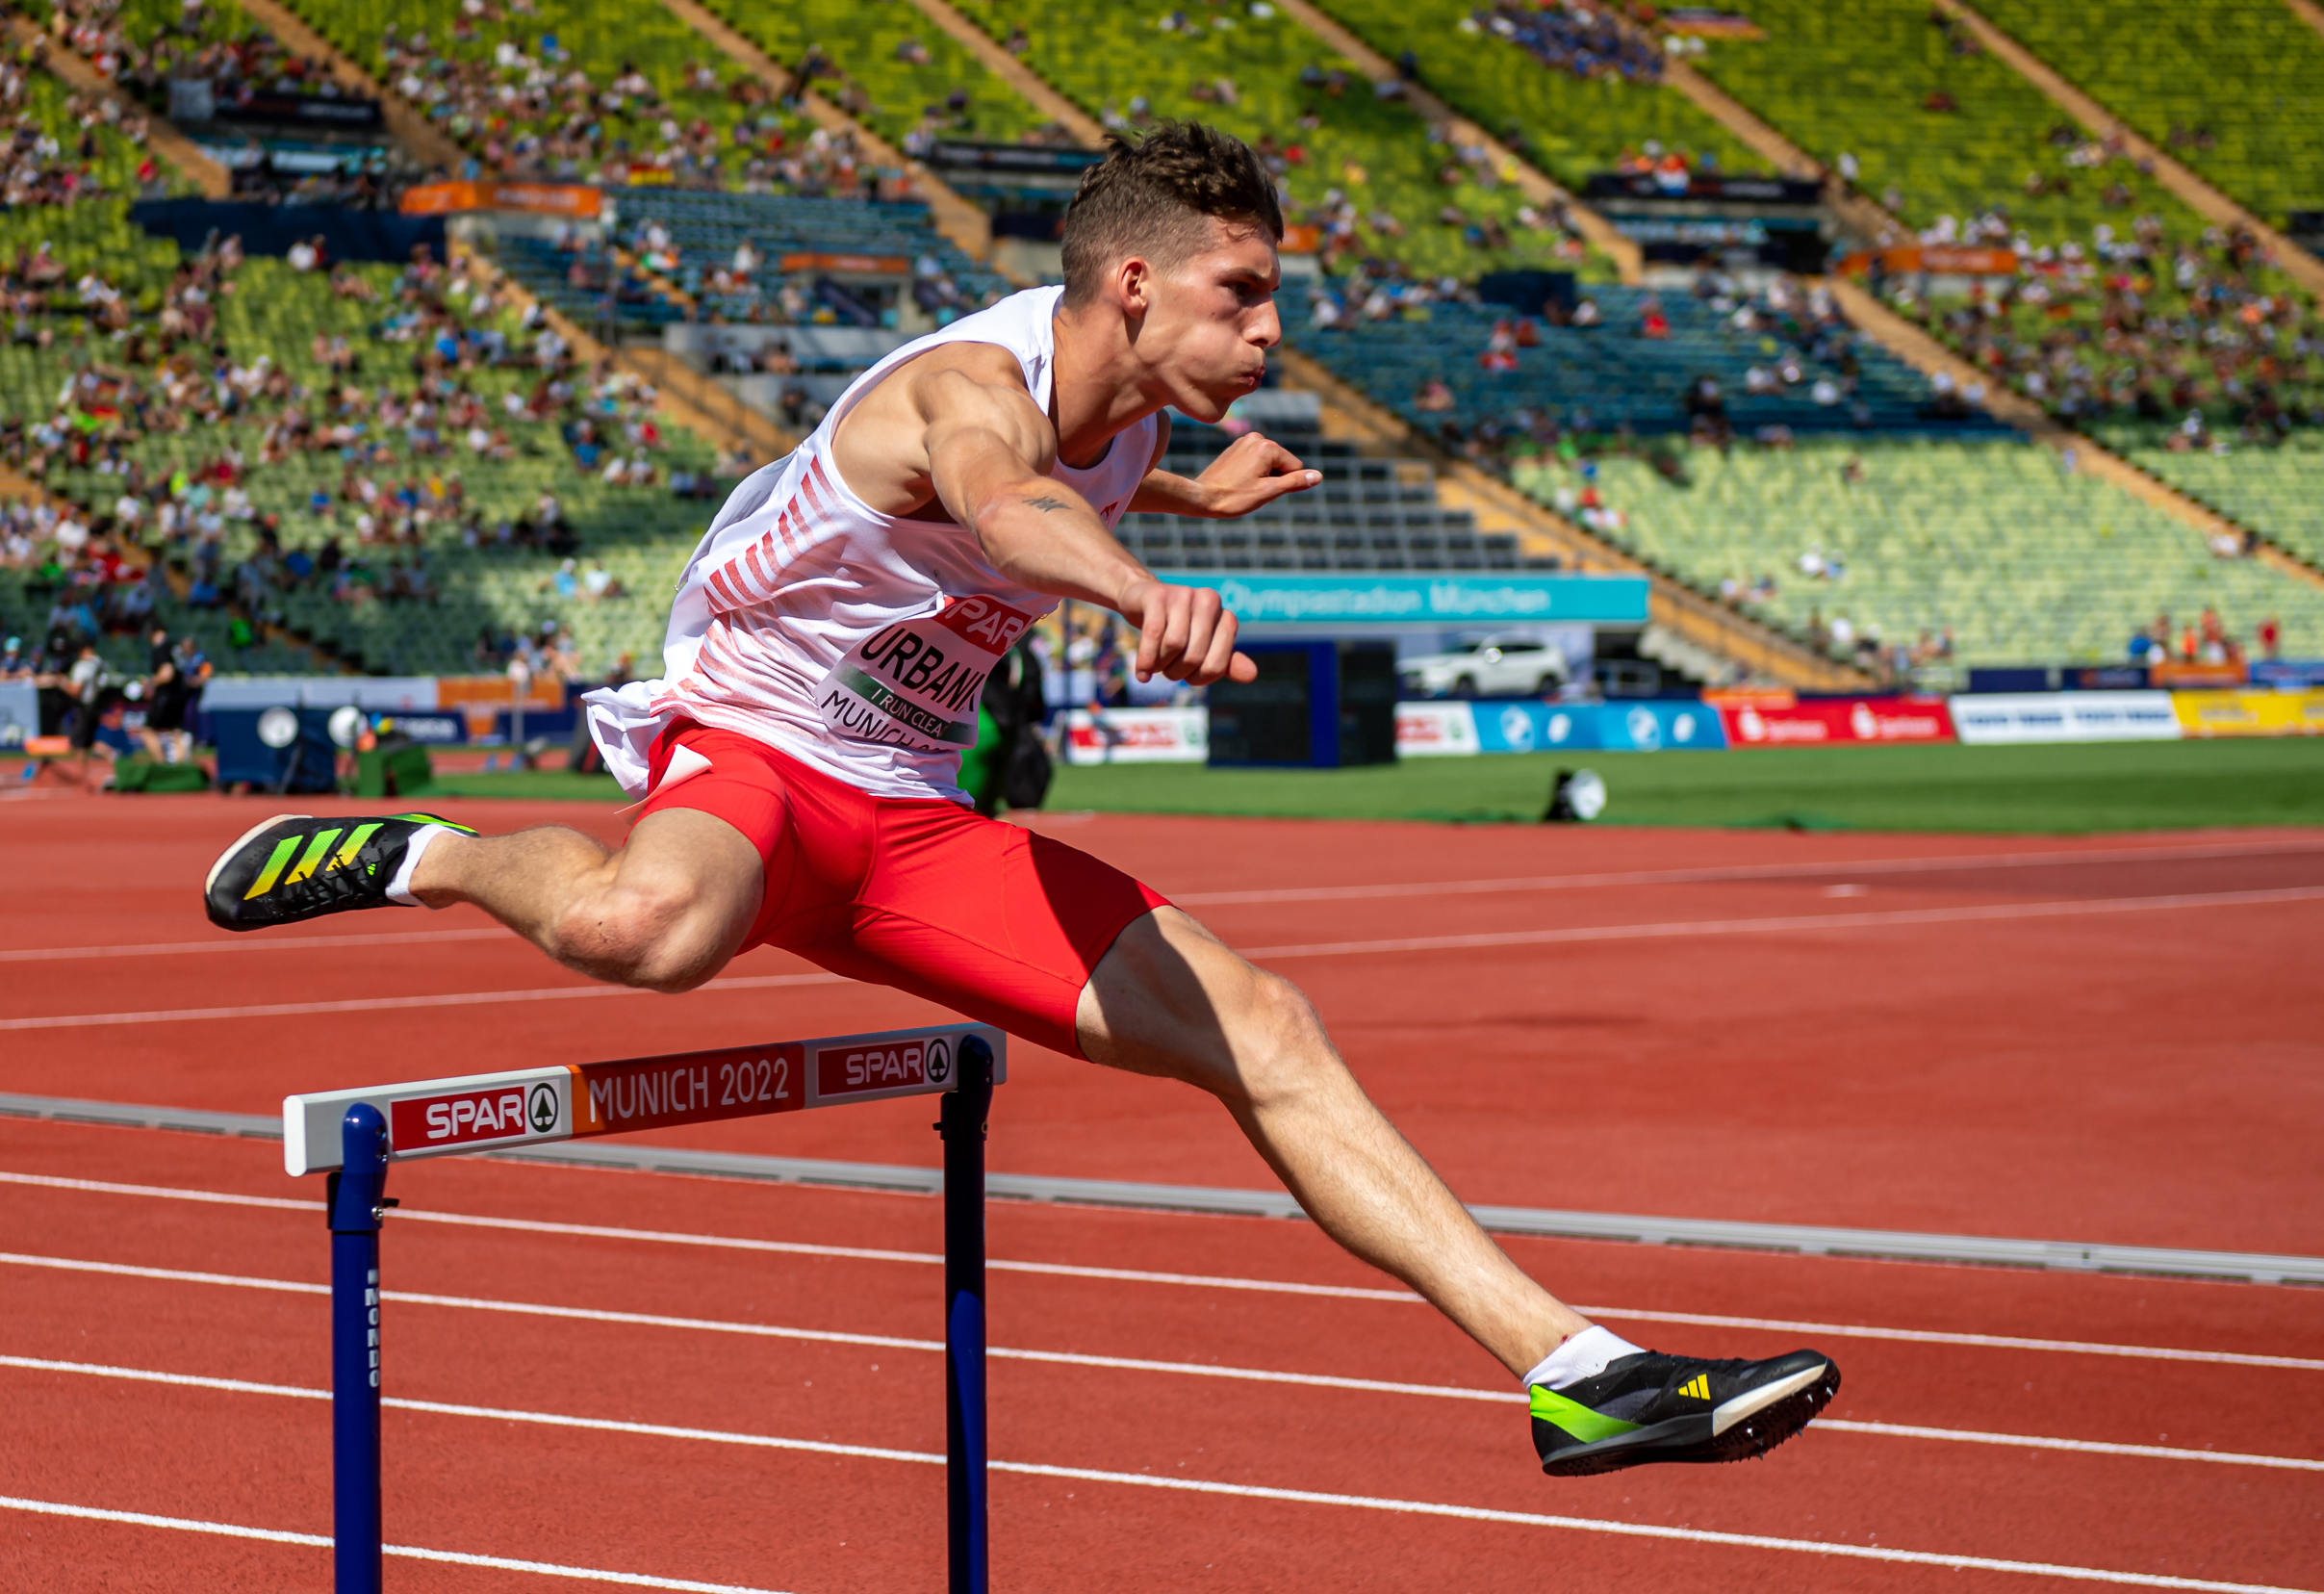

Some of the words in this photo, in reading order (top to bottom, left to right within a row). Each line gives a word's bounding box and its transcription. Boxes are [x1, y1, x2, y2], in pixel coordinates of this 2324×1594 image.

[944, 597, 1027, 651] PAR
[879, 693, 913, 720] RUN
[911, 710, 948, 737] CLEA
[846, 1047, 923, 1085] SPAR
[589, 1065, 709, 1123] MUNICH
[720, 1057, 789, 1106] 2022
[425, 1094, 524, 1140] SPAR
